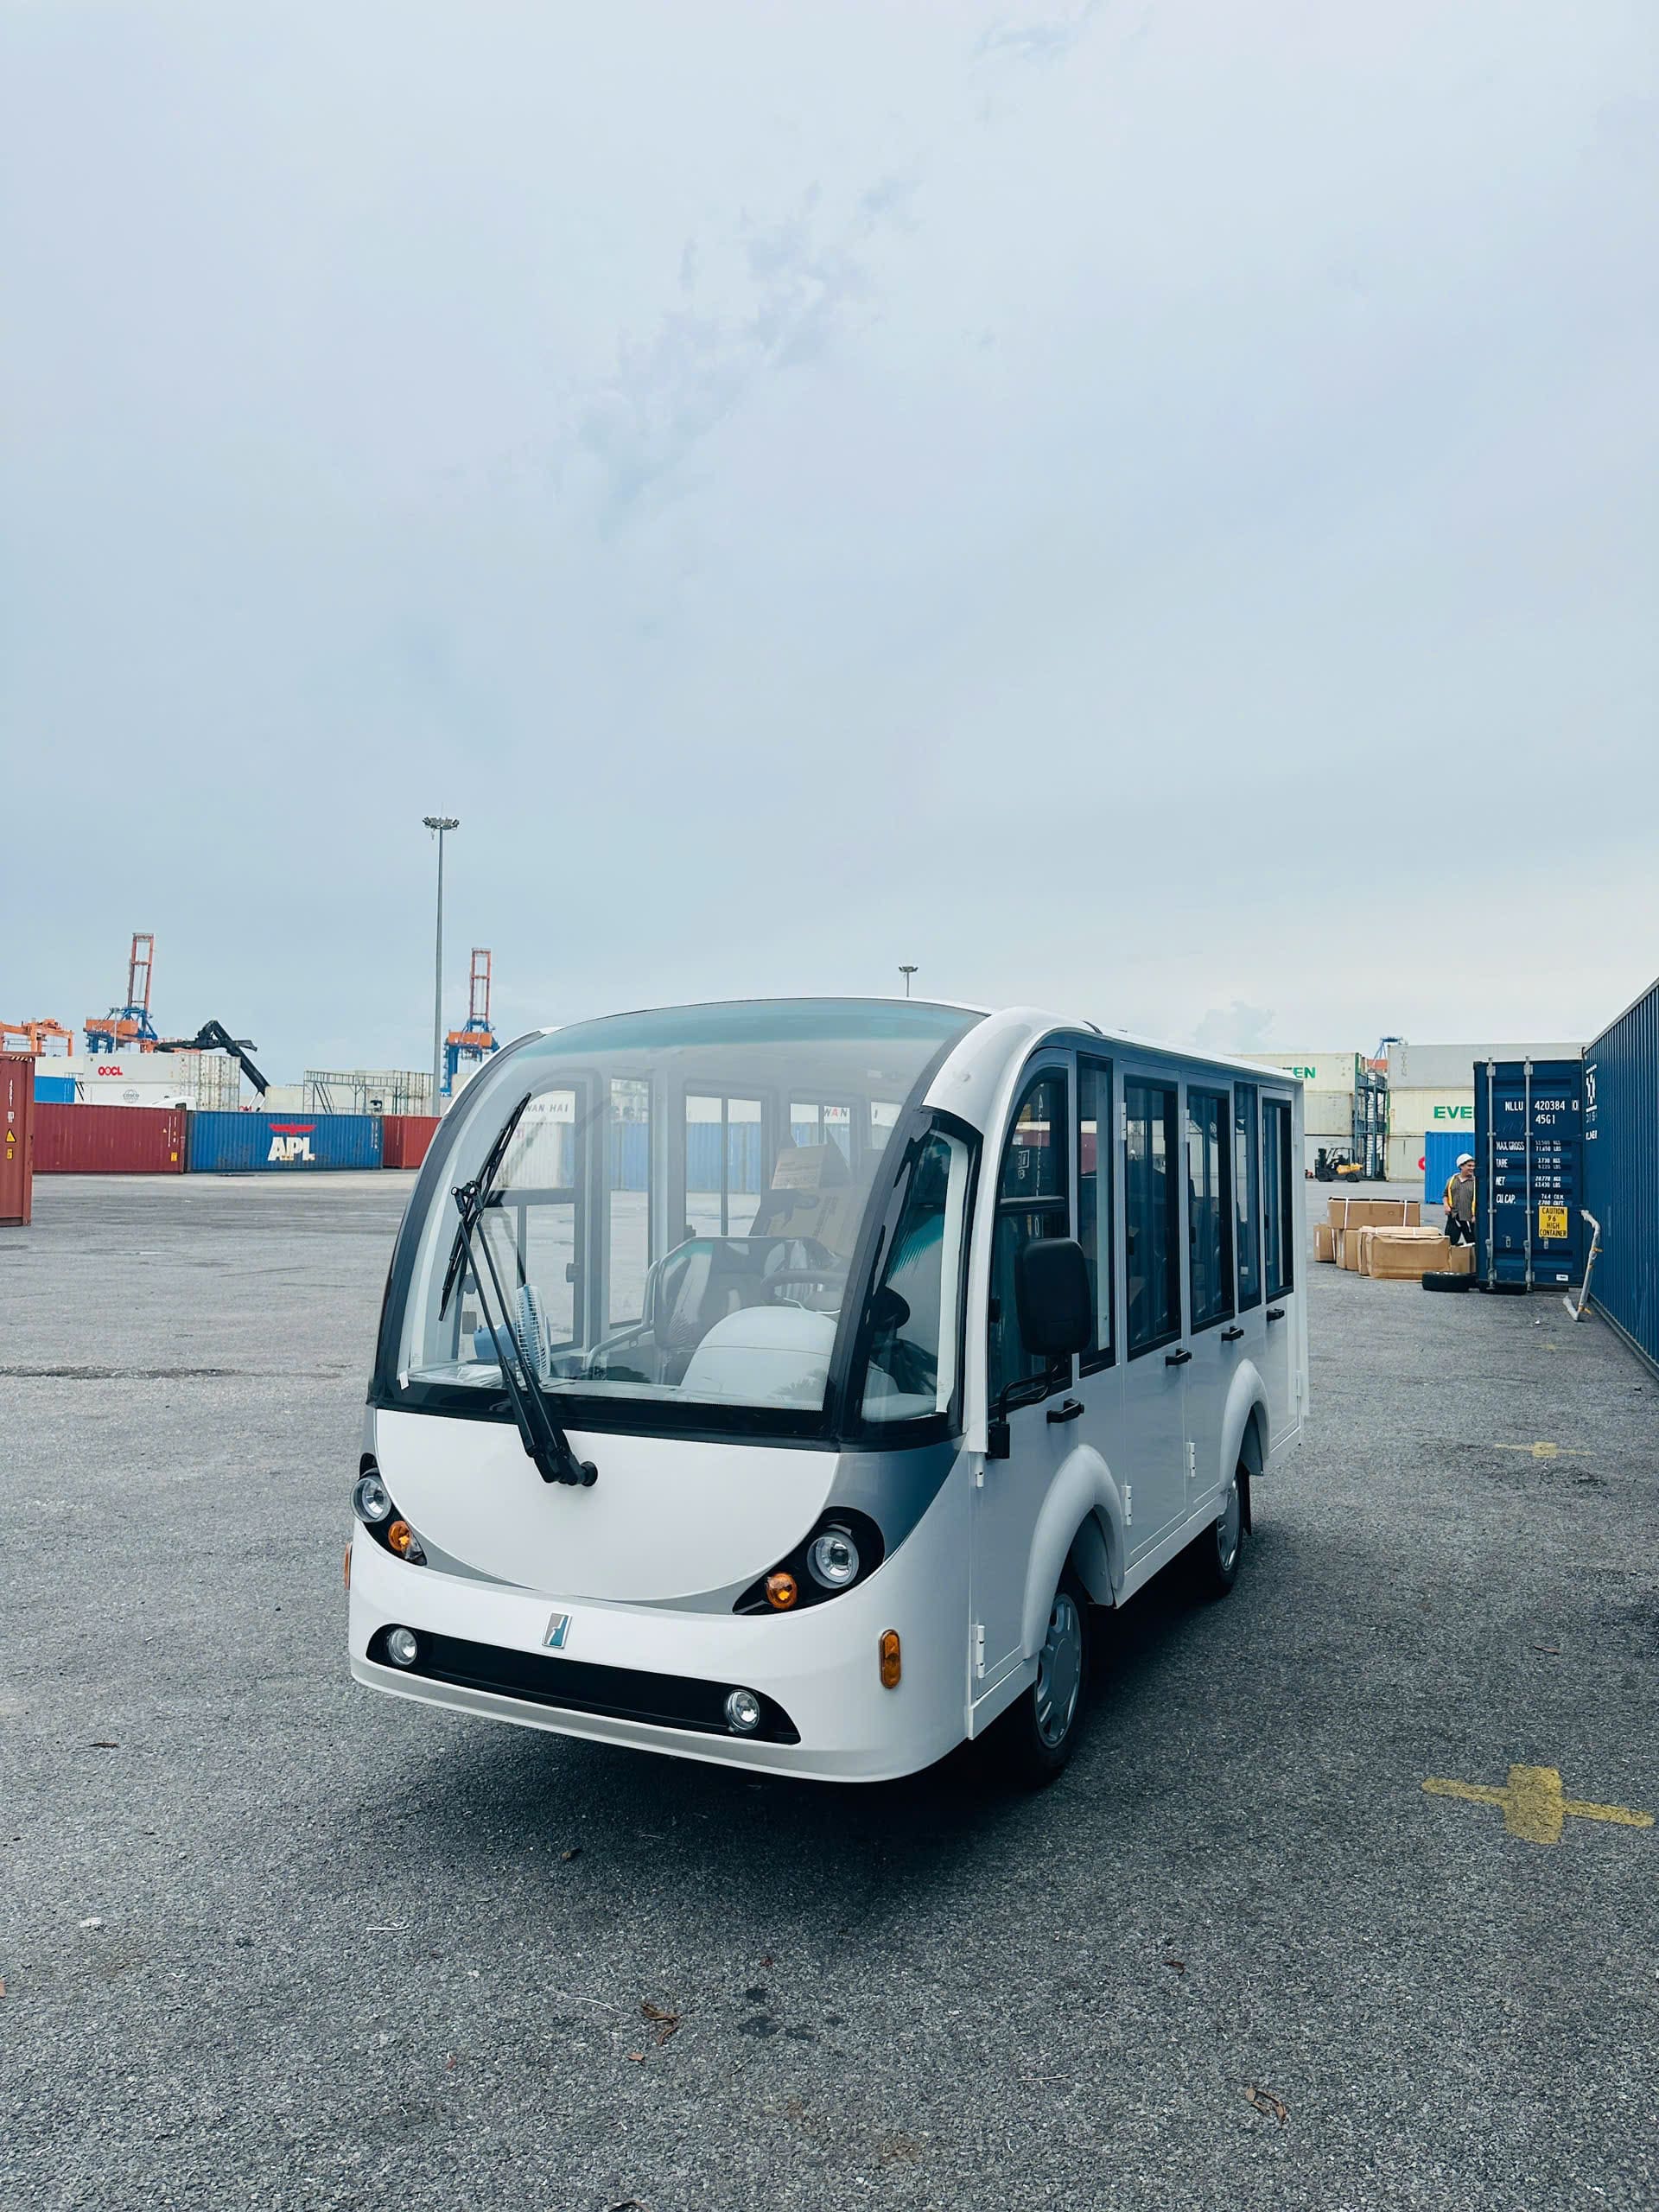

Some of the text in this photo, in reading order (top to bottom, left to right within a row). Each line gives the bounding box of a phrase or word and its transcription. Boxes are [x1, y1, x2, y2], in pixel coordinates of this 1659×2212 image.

[98, 1066, 123, 1076] OOCL
[1282, 1066, 1316, 1078] EN
[550, 1103, 569, 1113] HAI
[1505, 1100, 1579, 1111] NLLU 420384 0
[1433, 1106, 1475, 1119] EVE
[1535, 1114, 1555, 1124] 45G1
[267, 1136, 315, 1161] APL
[1496, 1176, 1506, 1186] NET
[1540, 1229, 1567, 1237] CONTAINER
